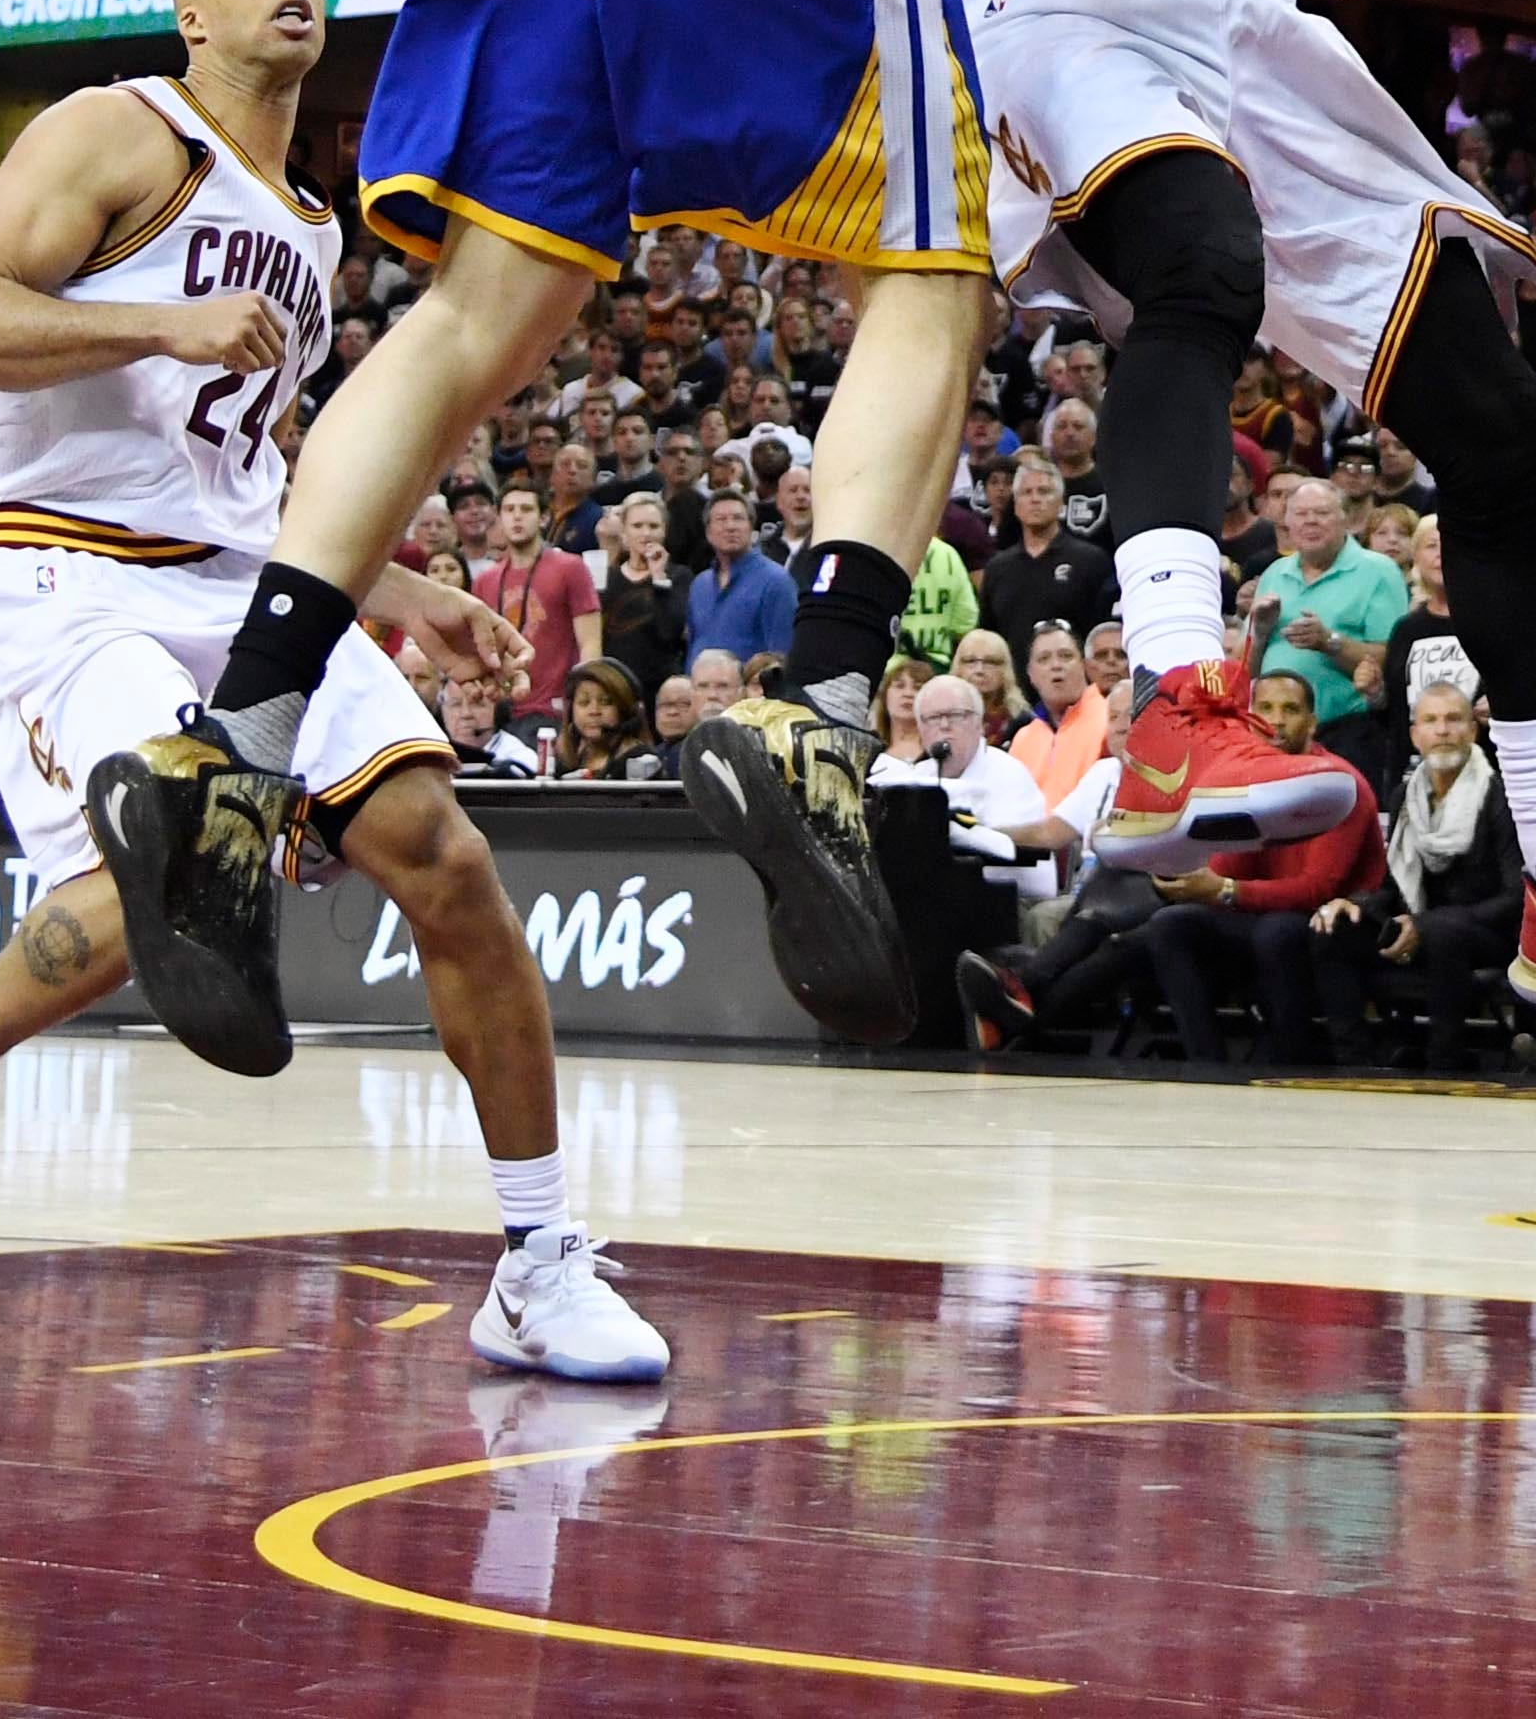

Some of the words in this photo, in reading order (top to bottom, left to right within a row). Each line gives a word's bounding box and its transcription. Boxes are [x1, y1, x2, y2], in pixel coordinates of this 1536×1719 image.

[186, 371, 283, 473] 24
[904, 587, 952, 616] ELP
[1409, 644, 1466, 664] peac
[525, 875, 693, 990] MÁS
